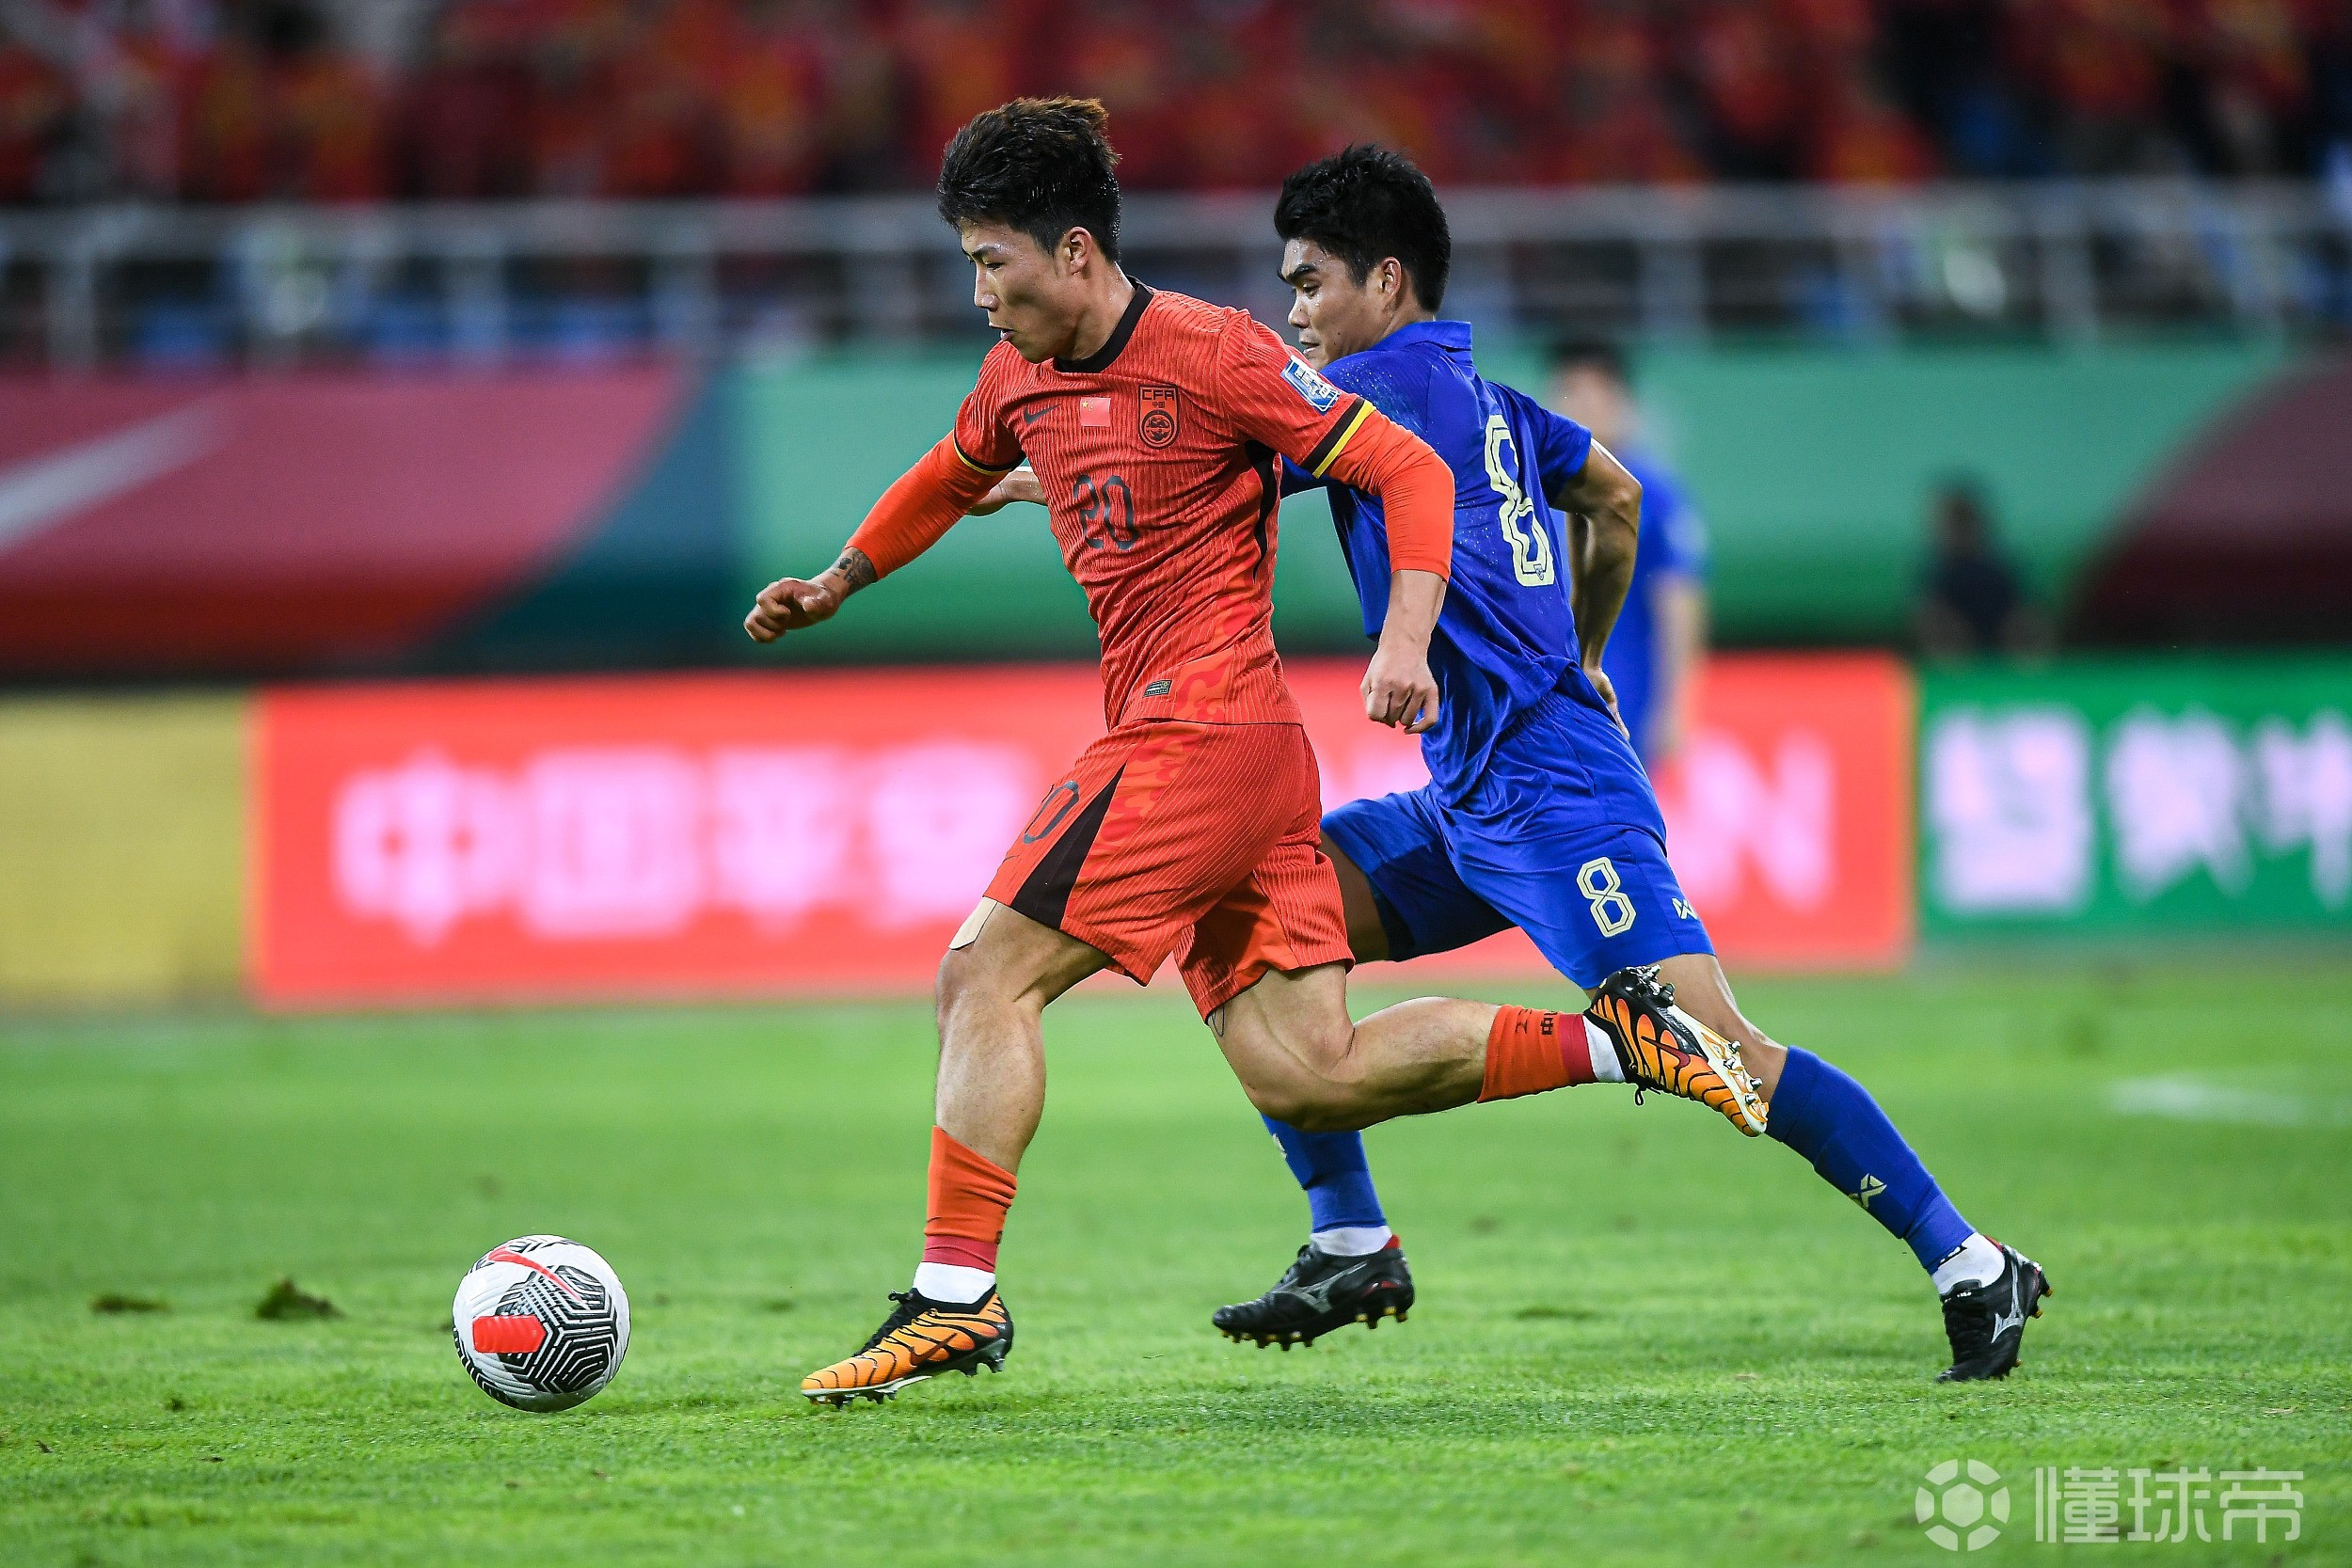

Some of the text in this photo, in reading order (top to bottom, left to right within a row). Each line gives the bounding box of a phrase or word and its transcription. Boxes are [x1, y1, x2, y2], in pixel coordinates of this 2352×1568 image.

[1141, 388, 1175, 401] CFA
[1073, 474, 1140, 550] 20
[1484, 414, 1555, 587] 8
[1022, 779, 1081, 845] 0
[1576, 856, 1637, 938] 8
